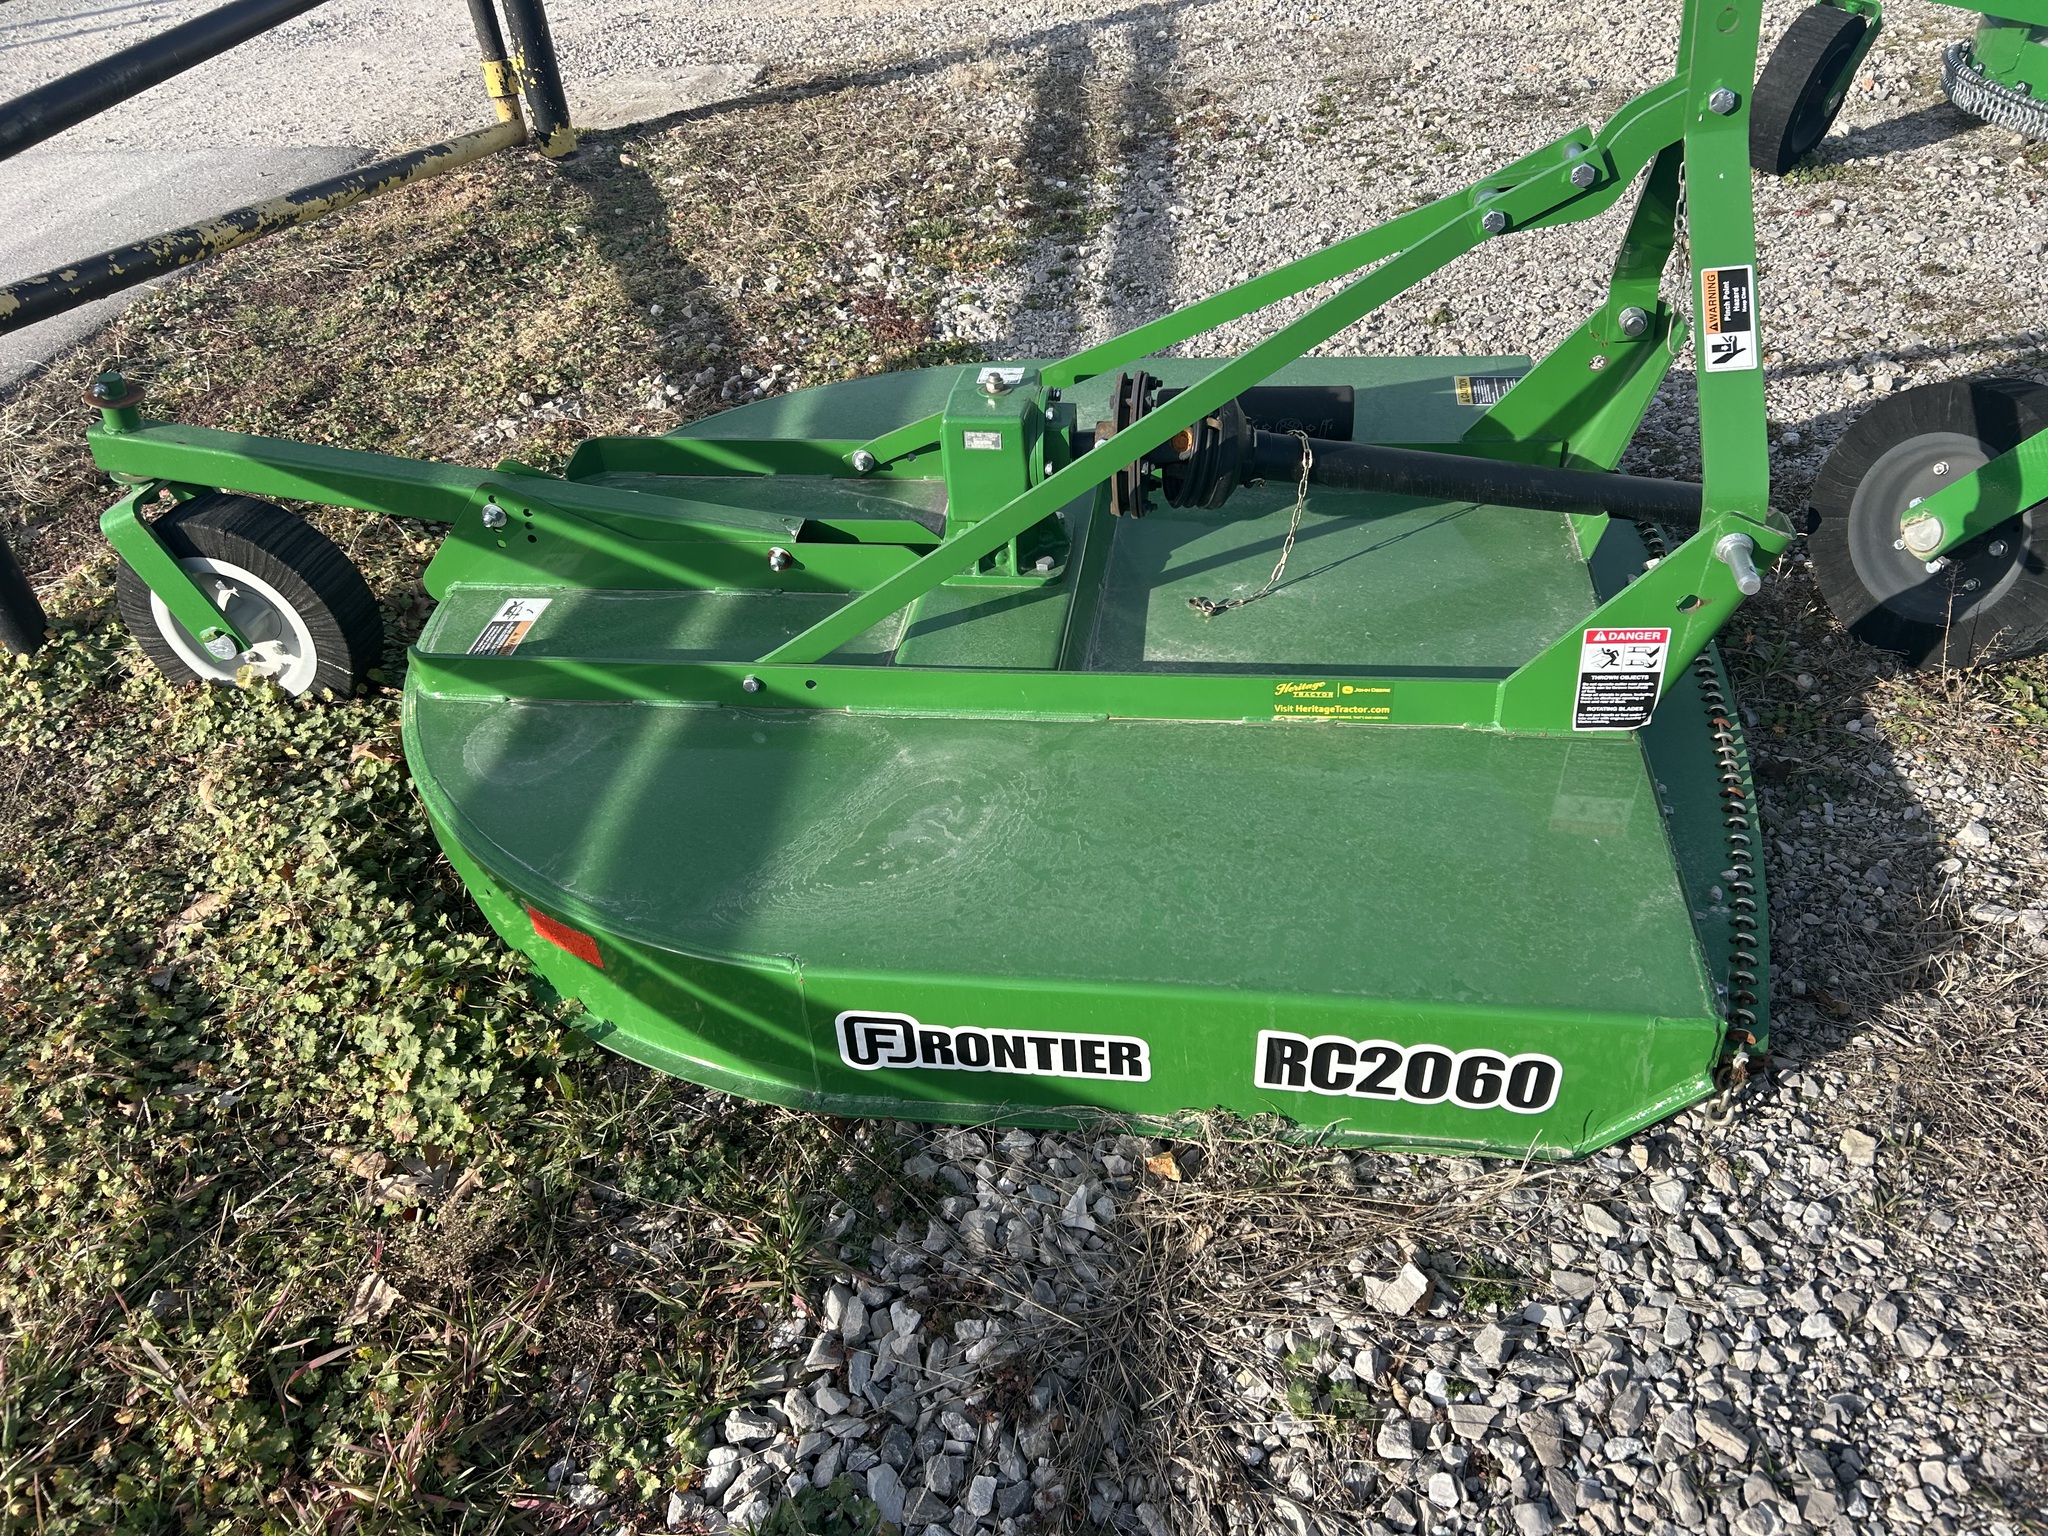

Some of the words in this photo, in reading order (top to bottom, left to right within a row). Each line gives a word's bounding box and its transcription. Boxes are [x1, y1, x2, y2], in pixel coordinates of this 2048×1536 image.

[1707, 274, 1718, 322] WARNING
[1732, 287, 1740, 312] Hazard
[1723, 300, 1731, 321] Pinch
[1459, 378, 1470, 399] CAUTION
[1608, 631, 1661, 641] DANGER
[1274, 682, 1326, 696] Heritage
[1274, 704, 1294, 713] Visit
[1295, 704, 1390, 715] HeritageTractor.com
[843, 1016, 1143, 1077] FRONTIER
[1264, 1037, 1556, 1109] RC2060
